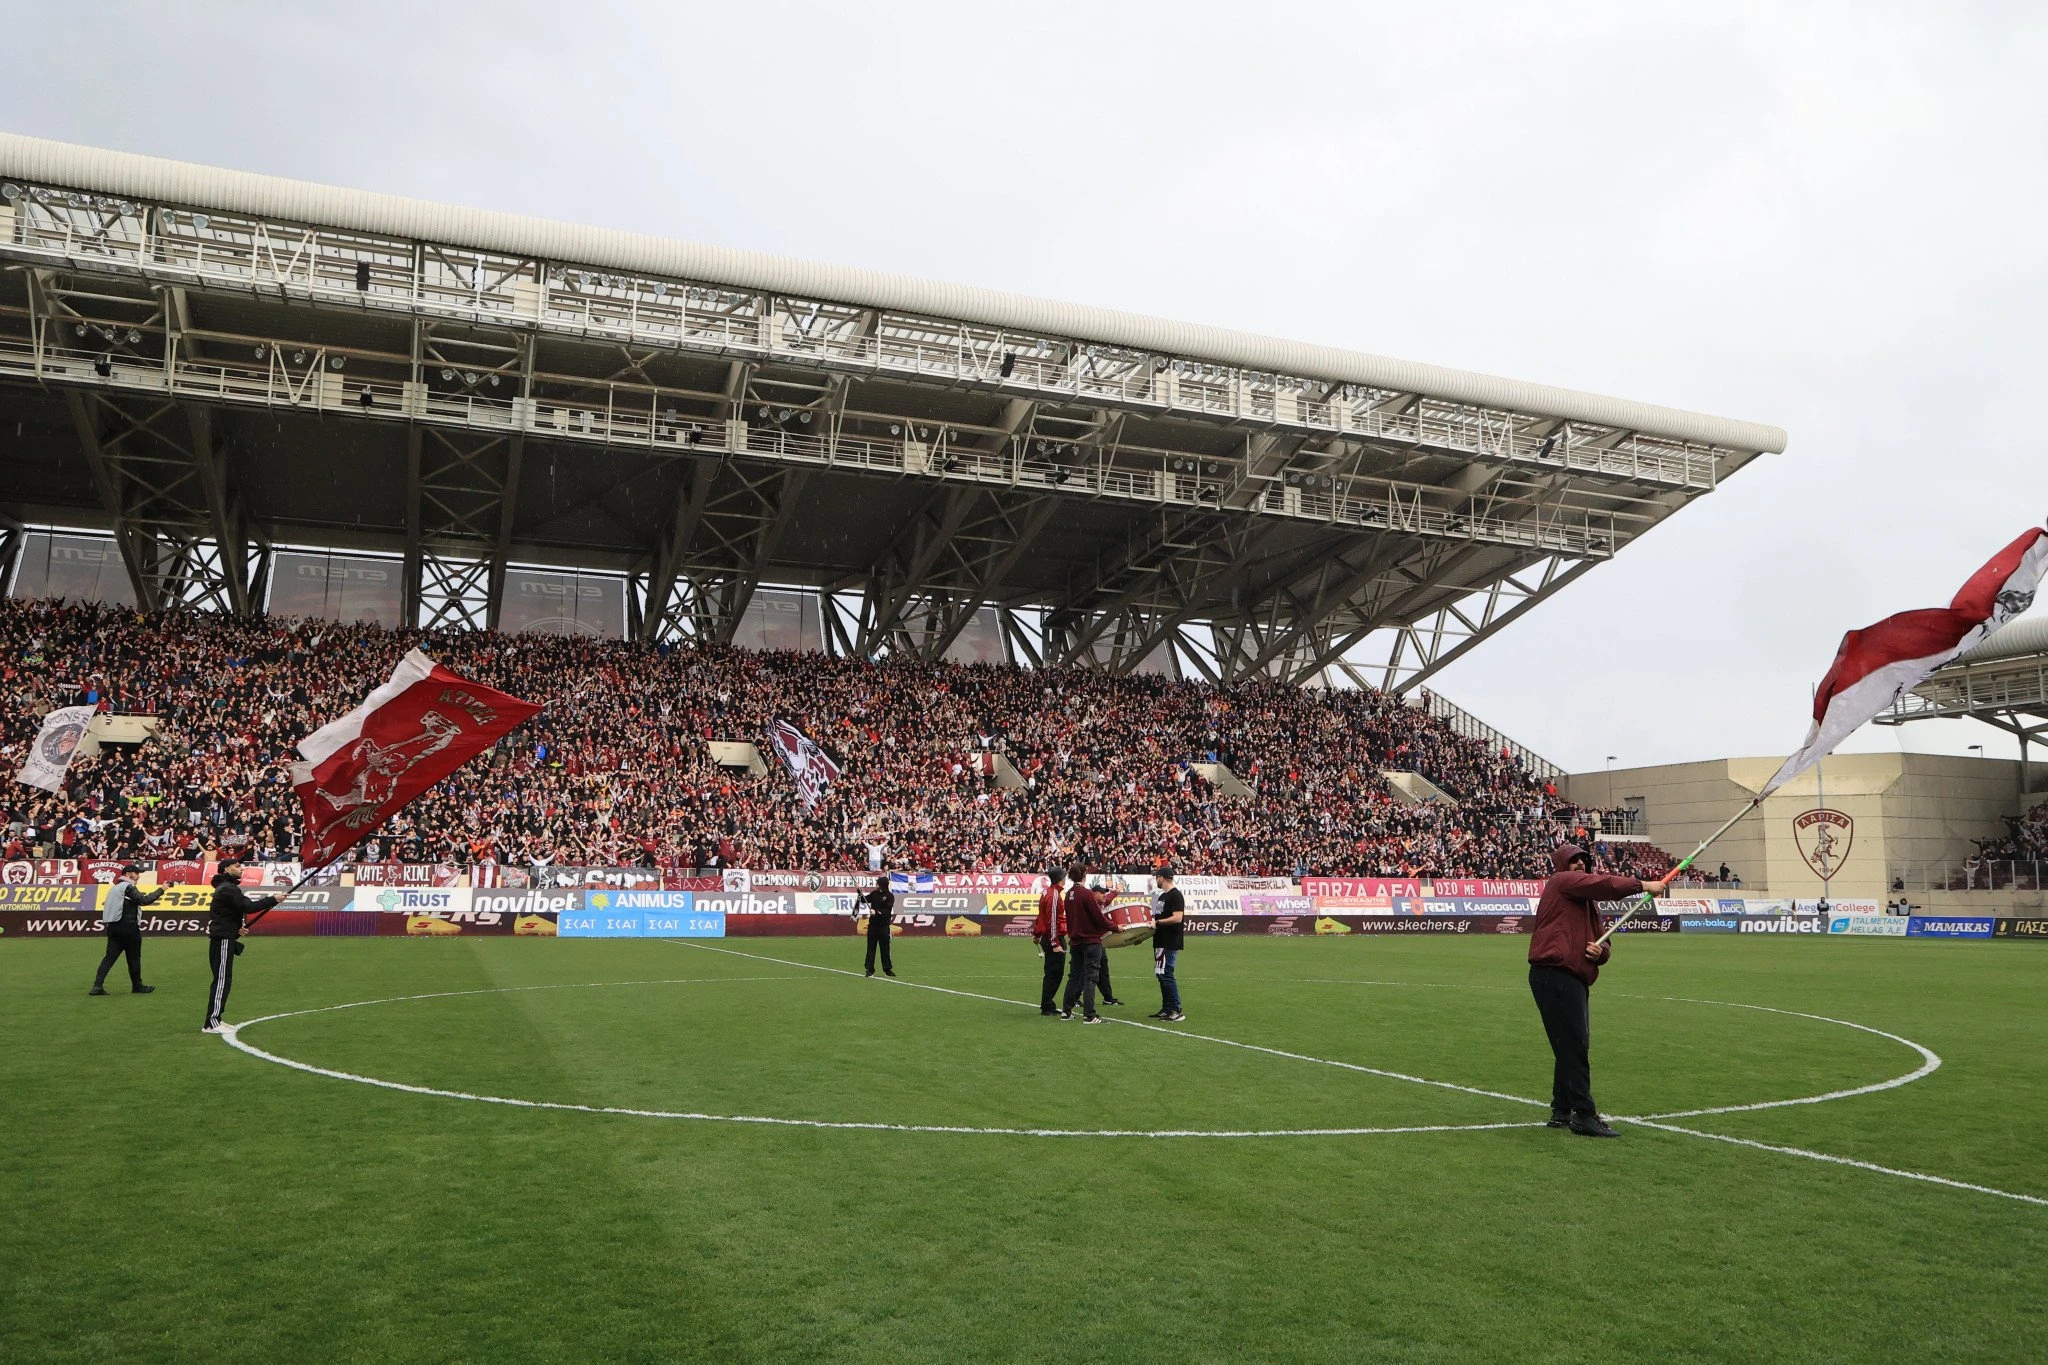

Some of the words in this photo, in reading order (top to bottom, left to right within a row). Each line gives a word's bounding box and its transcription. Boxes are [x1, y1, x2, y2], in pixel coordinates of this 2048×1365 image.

[356, 864, 384, 881] KATE
[403, 865, 431, 881] RINI
[751, 873, 800, 887] CRIMSON
[1306, 881, 1368, 897] FORZA
[1435, 880, 1458, 895] ΟΣΟ
[13, 887, 85, 903] ΤΣΟΓΙΑΣ
[397, 889, 450, 907] TRUST
[474, 891, 577, 912] novibet
[615, 893, 685, 909] ANIMUS
[695, 894, 788, 914] novibet
[903, 897, 968, 908] ETEM
[1194, 899, 1238, 910] TAXINI
[1275, 897, 1311, 909] wheel
[1463, 901, 1530, 911] KARGOGLOU
[1797, 904, 1876, 914] AegnCollege
[1362, 919, 1471, 932] www.skechers.gr
[1740, 916, 1822, 933] novibet
[1852, 918, 1906, 926] ITALMETANO
[1924, 922, 1990, 933] MAMAKAS
